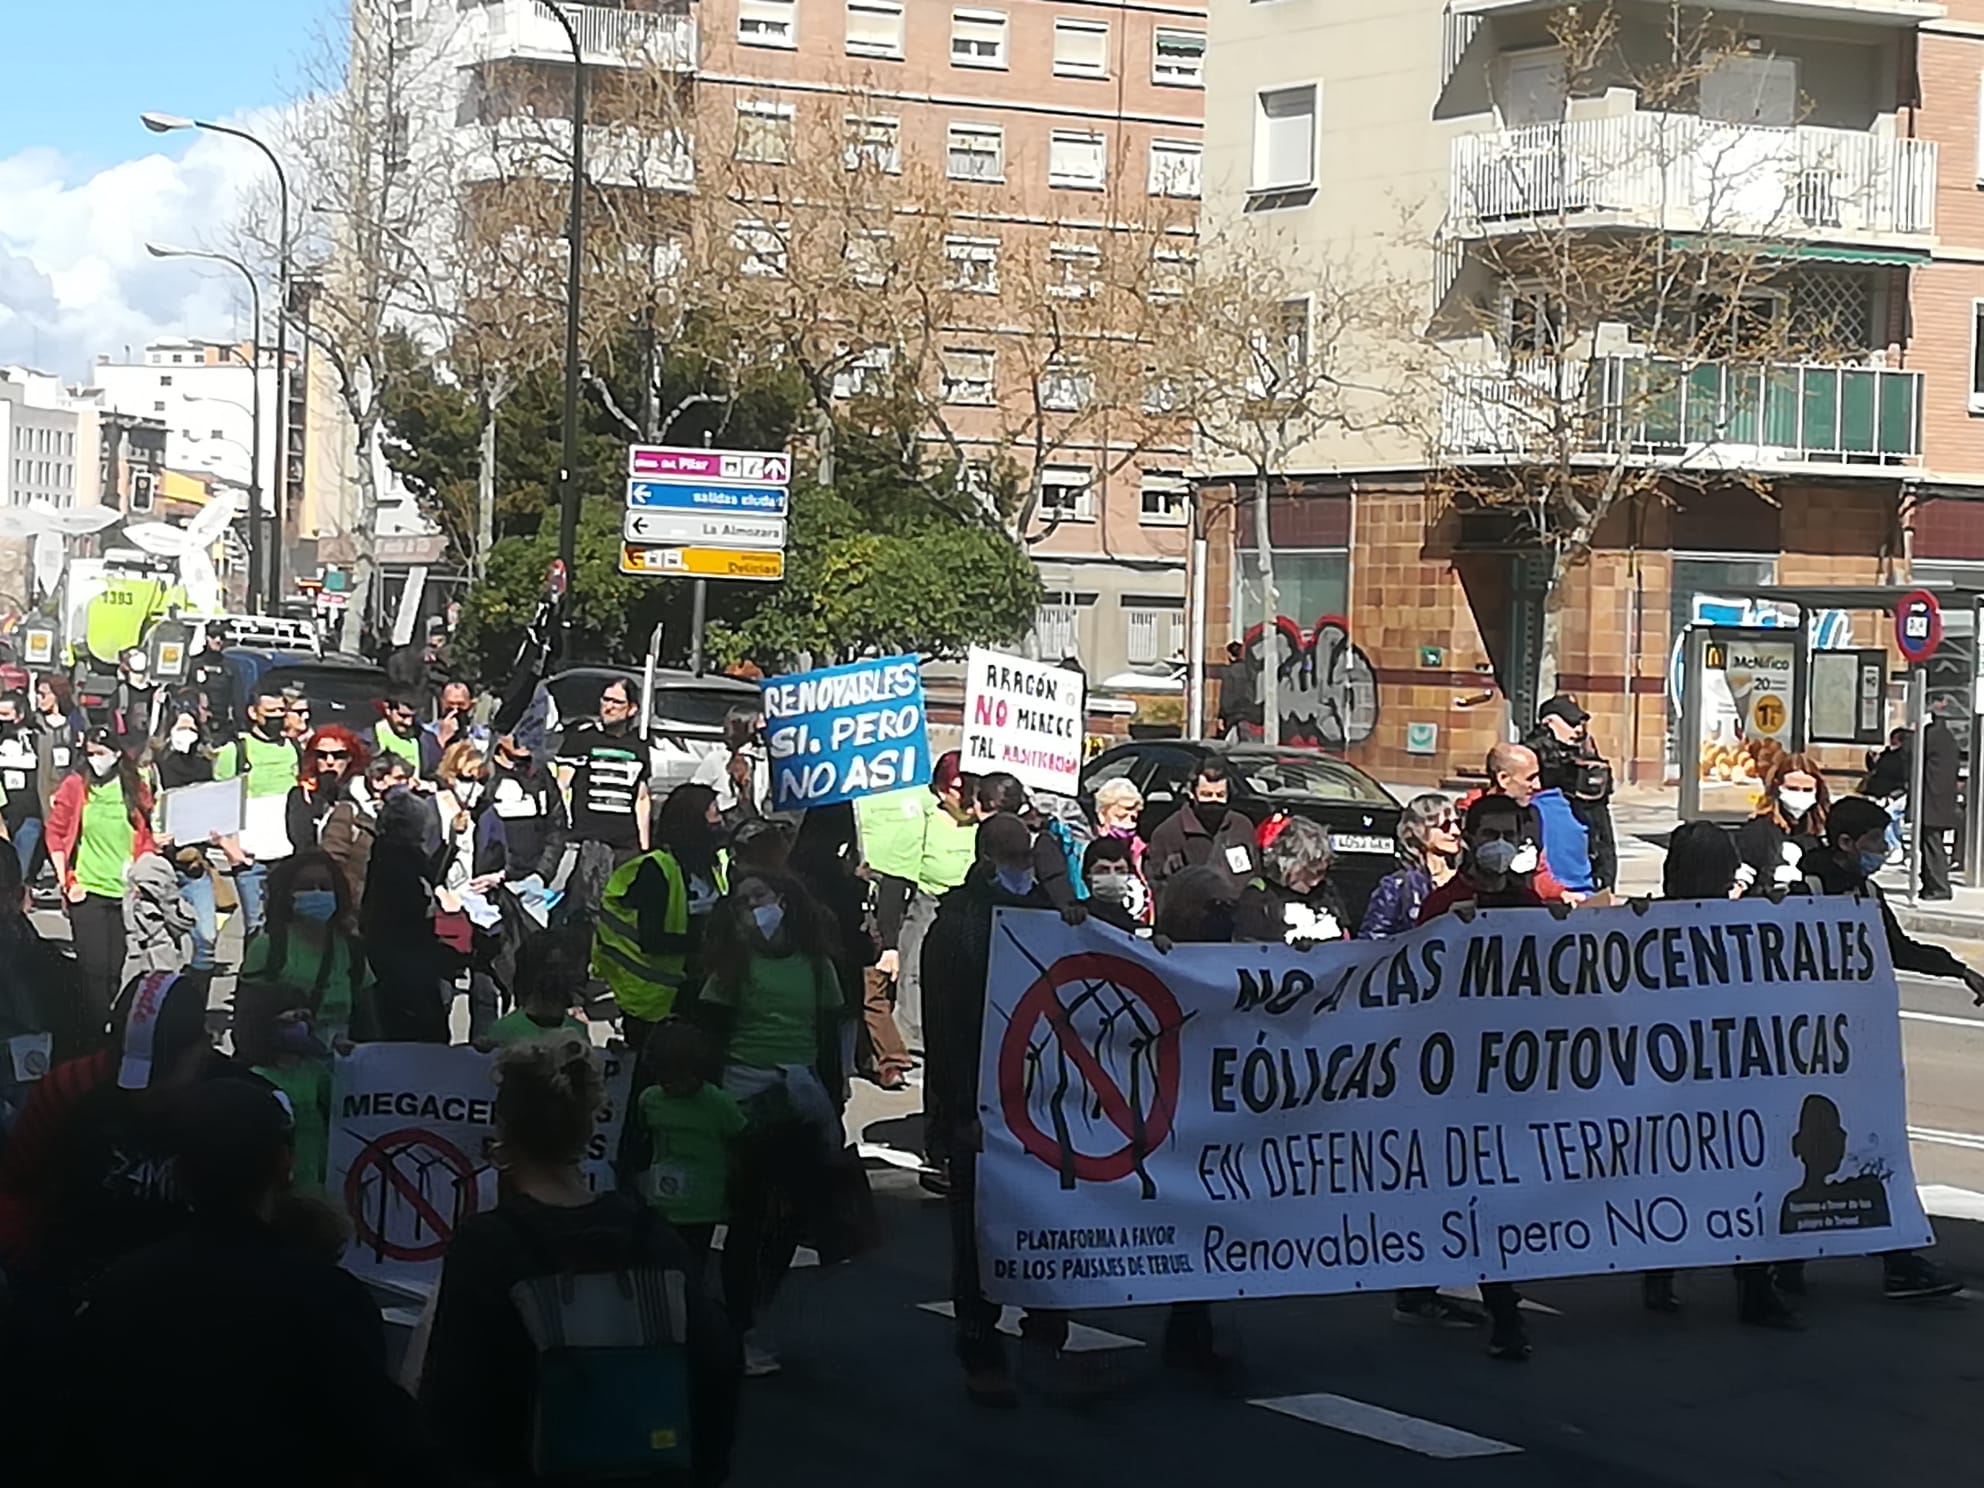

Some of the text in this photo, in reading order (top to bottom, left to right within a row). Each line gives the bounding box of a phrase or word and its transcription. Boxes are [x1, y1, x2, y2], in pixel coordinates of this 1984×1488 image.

[703, 524, 780, 538] La Almozara
[728, 562, 778, 574] Delicias
[764, 662, 917, 719] RENOVABLES
[986, 664, 1058, 701] ARAGÓN
[1754, 677, 1771, 690] 20
[831, 705, 920, 751] PERO
[975, 694, 1074, 738] NO MERECE
[969, 735, 996, 760] TAL
[779, 746, 916, 803] NO ASI
[1233, 968, 1315, 1015] NO
[1359, 938, 1447, 1008] LAS
[1459, 921, 1875, 998] MACROCENTRALES
[1211, 1013, 1850, 1113] EÓLICAS O FOTOVOLTAICAS
[1199, 1109, 1766, 1200] EN DEFENSA DEL TERRITORIO
[1015, 1226, 1176, 1250] PLATAFORMA A FAVOR
[1203, 1191, 1766, 1274] Renovables SÍ pero NO así
[994, 1254, 1195, 1280] DE LOS PAISAJES DE TERUEL
